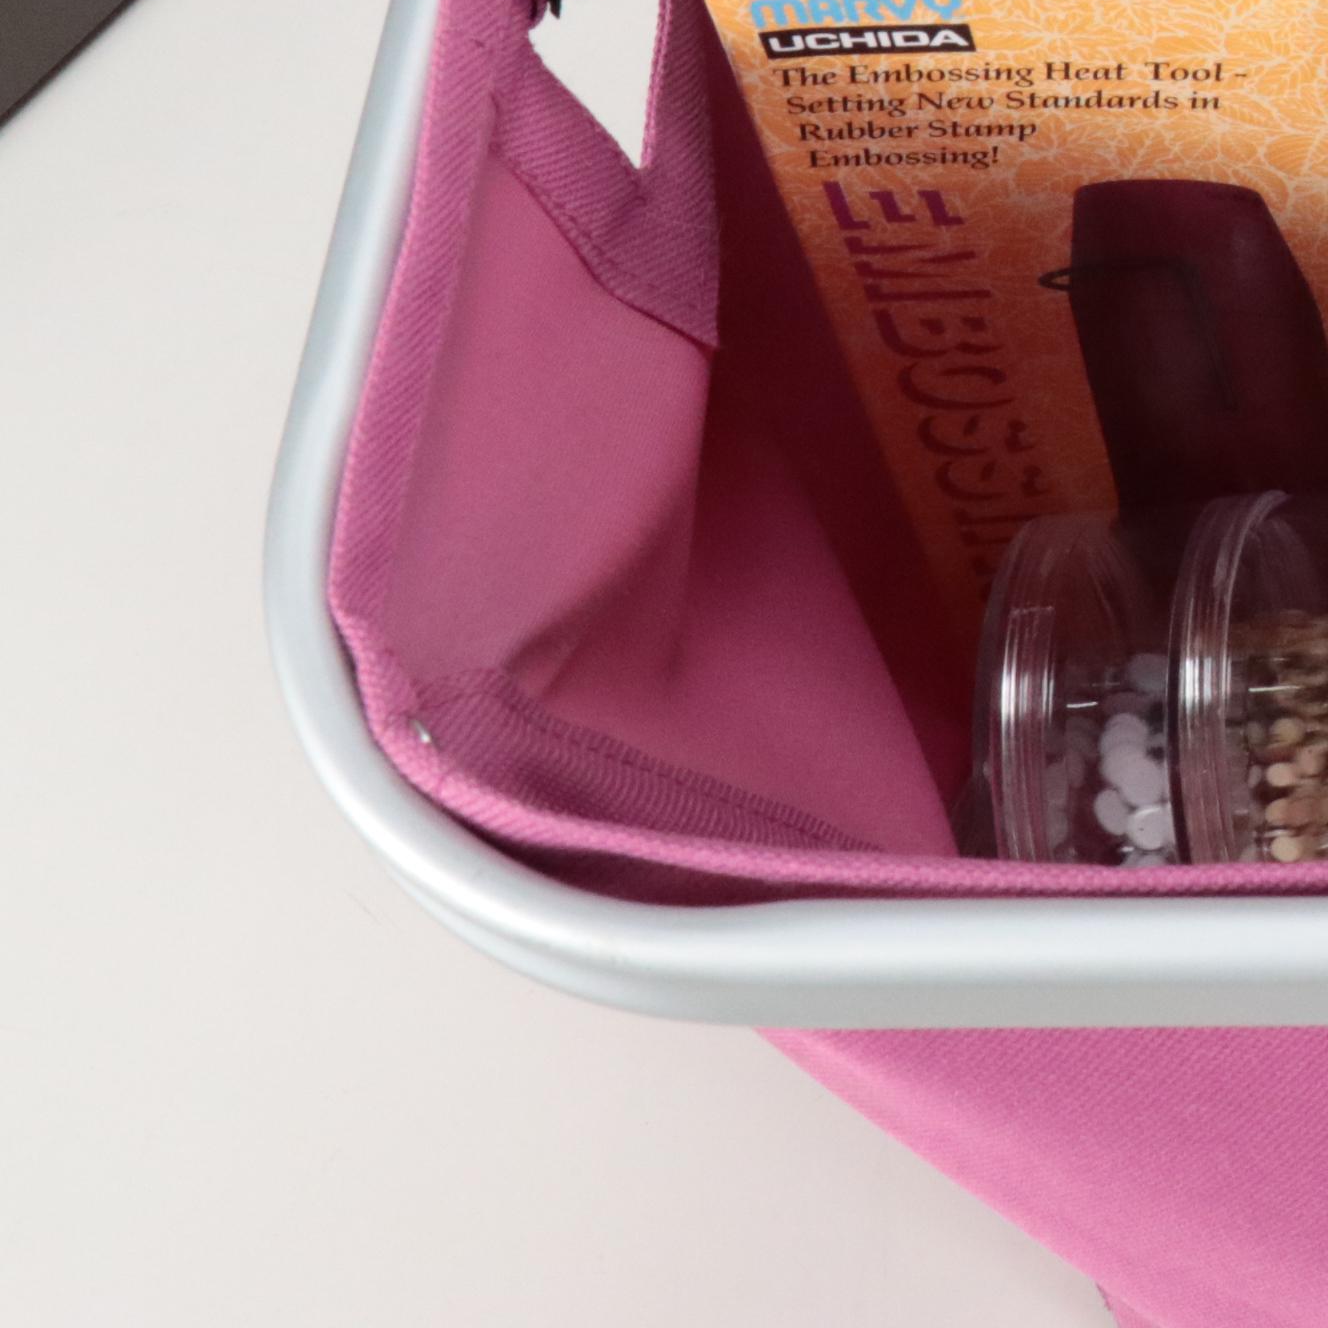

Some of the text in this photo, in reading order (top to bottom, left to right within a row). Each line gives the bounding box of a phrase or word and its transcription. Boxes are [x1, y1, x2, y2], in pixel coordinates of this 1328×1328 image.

[765, 28, 971, 52] UCHIDA
[773, 66, 837, 88] The
[847, 63, 1035, 88] Embossing
[1044, 62, 1128, 82] Heat
[1143, 62, 1224, 83] Tool
[785, 90, 1222, 117] Setting New Standards in
[799, 120, 1038, 145] Rubber Stamp
[809, 146, 1001, 170] Embossing!
